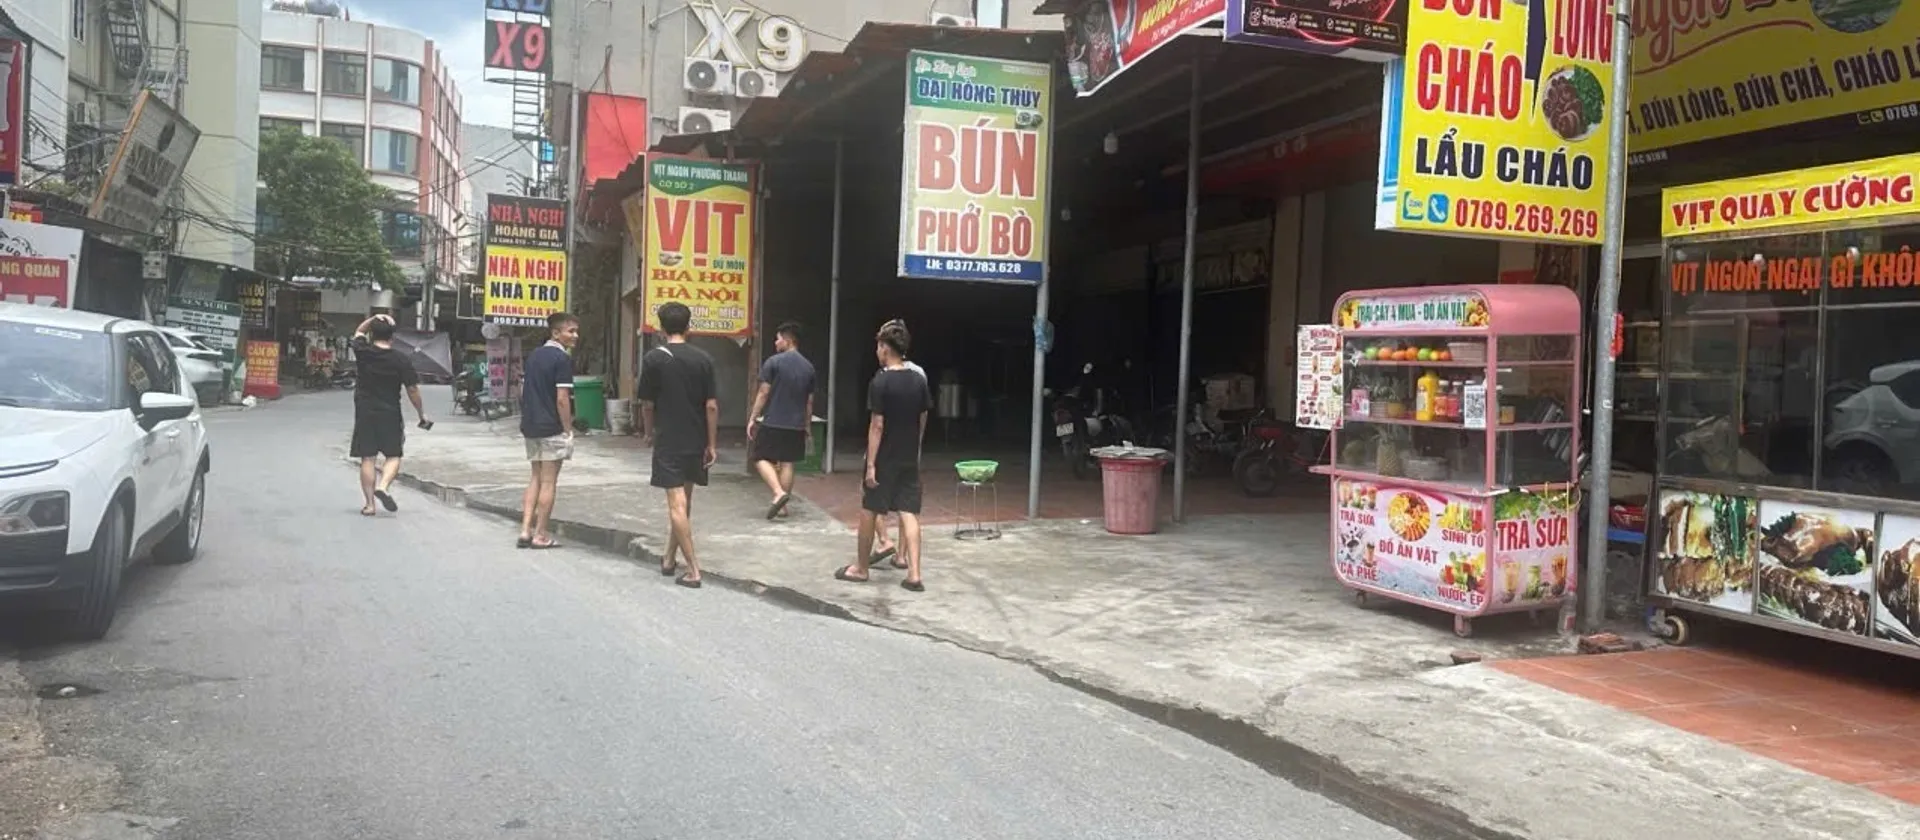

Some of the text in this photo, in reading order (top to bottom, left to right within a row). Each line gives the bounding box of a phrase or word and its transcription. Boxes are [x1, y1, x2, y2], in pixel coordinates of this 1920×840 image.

[490, 20, 546, 69] X9
[688, 1, 806, 71] X9
[1417, 41, 1522, 120] CHÁO
[1641, 96, 1679, 130] BÚN
[1734, 72, 1779, 111] BÚN
[1833, 46, 1900, 91] CHÁO
[918, 118, 1037, 198] BÚN
[1415, 127, 1593, 190] LẨU CHÁO
[1455, 198, 1598, 238] 0789.269.269
[1671, 175, 1913, 231] VỊT QUAY CƯỜNG
[495, 222, 559, 239] HOÀNG GIA
[654, 197, 744, 267] VỊT
[917, 202, 1032, 258] PHỞ BÒ
[488, 254, 520, 279] NHÀ
[651, 268, 693, 282] BIA
[1671, 263, 1699, 296] VỊT
[1704, 258, 1762, 292] NGON
[1767, 255, 1823, 296] NGẠI
[490, 281, 523, 300] NHÀ
[655, 283, 741, 304] HÀ NỘI
[1379, 538, 1395, 555] ĐỒ
[1416, 546, 1439, 568] VẶT
[1497, 511, 1569, 551] TRÀ SỮA
